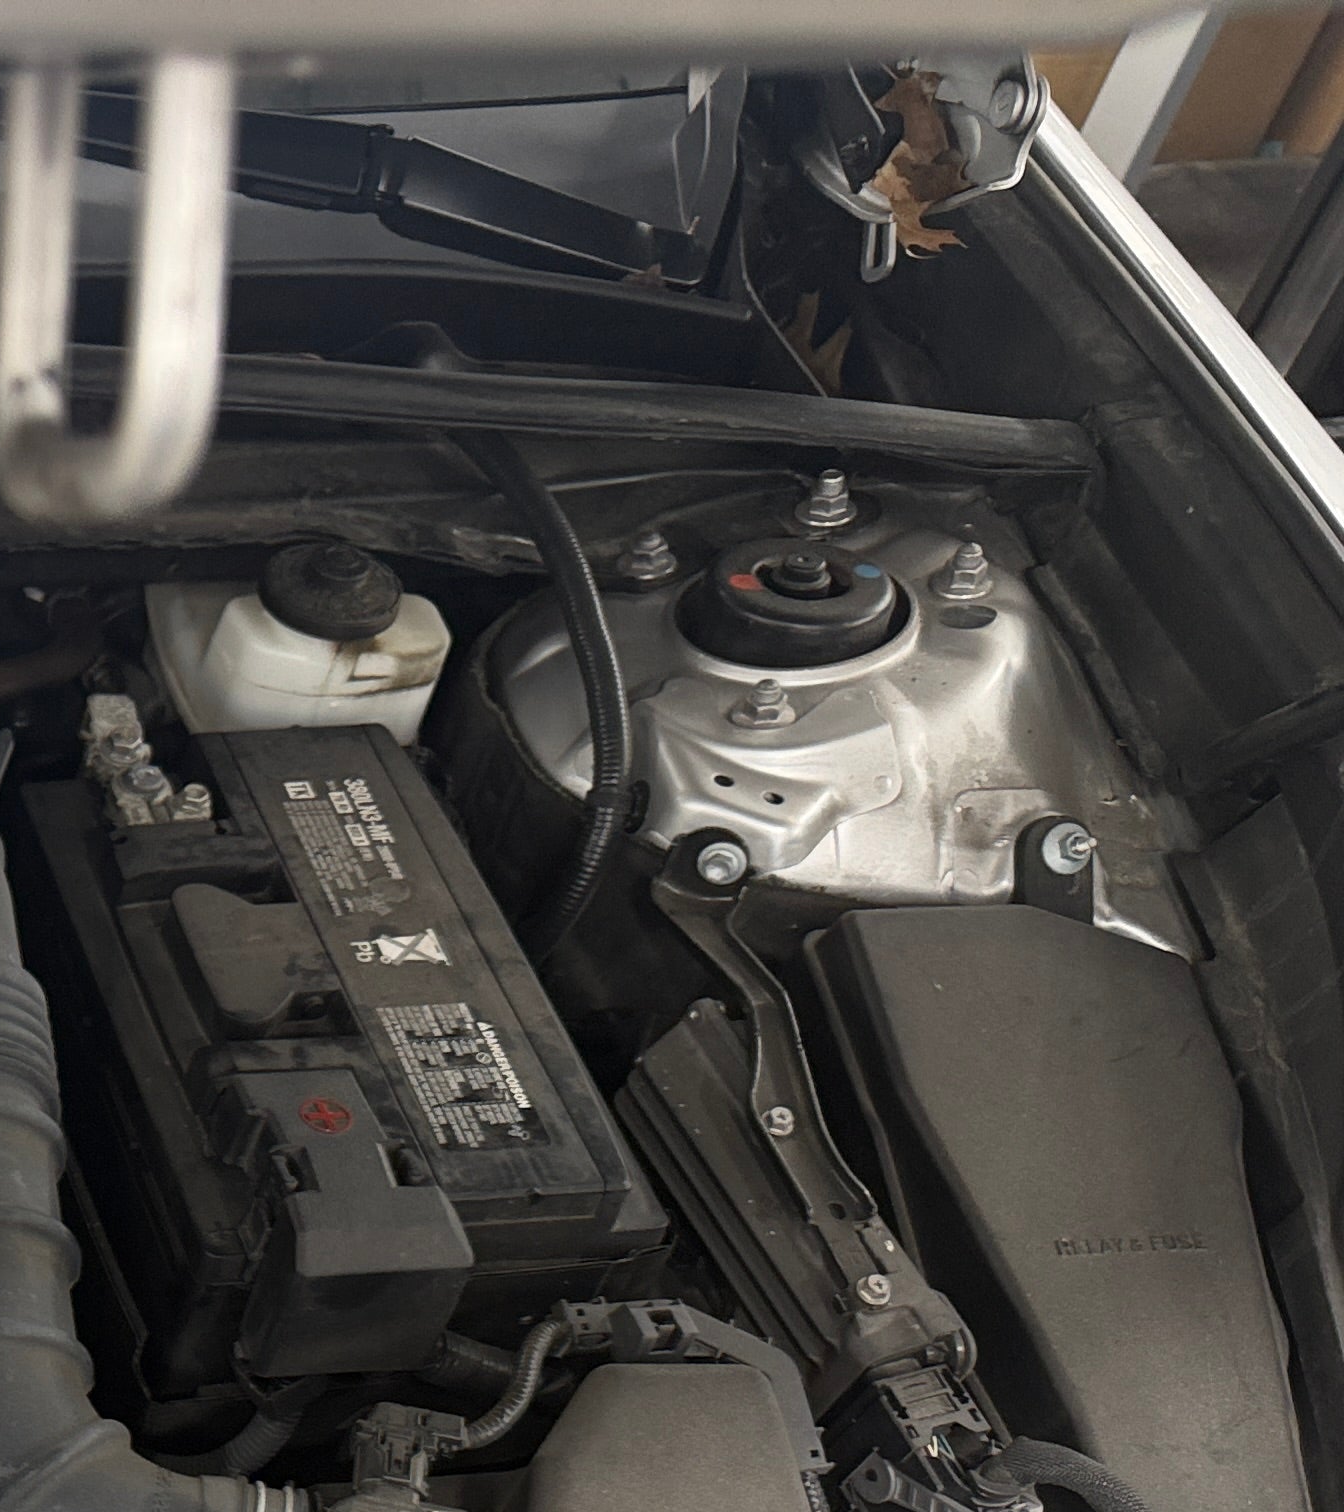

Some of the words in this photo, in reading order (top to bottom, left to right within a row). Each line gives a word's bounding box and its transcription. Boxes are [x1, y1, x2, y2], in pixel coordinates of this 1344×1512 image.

[350, 941, 375, 962] Pb
[501, 1070, 532, 1108] POISON
[1149, 1231, 1209, 1250] FUSE
